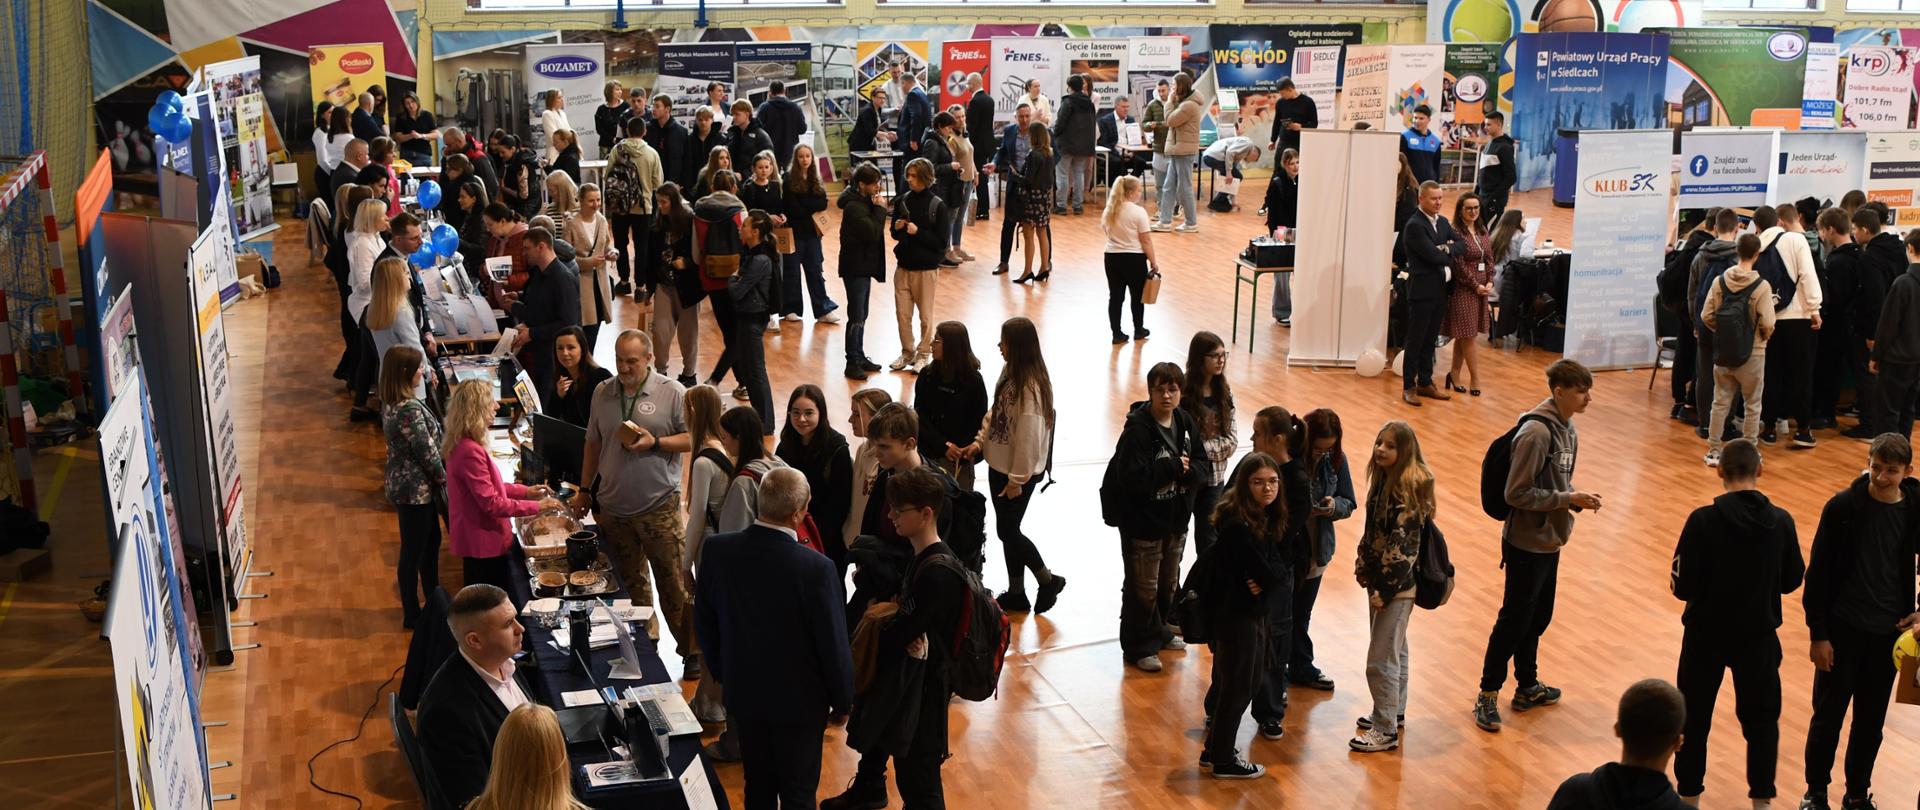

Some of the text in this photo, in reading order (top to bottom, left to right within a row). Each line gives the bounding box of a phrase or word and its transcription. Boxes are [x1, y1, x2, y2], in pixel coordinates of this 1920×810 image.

[1288, 30, 1311, 38] Oglądaj
[1065, 42, 1127, 52] Cięcie laserowe
[1318, 38, 1344, 46] kablowej
[950, 48, 979, 60] FENES
[1005, 50, 1042, 62] FENES
[1313, 51, 1337, 61] SIEDLCE
[1552, 51, 1662, 66] Powiatowy Urząd Pracy
[1851, 53, 1883, 70] krp
[540, 62, 593, 73] BOZAMET
[1550, 67, 1599, 78] w Siedlcach
[1854, 98, 1892, 107] 101,7 fm
[1859, 112, 1897, 121] 106,0 fm
[1713, 155, 1737, 166] Znajdź
[1791, 152, 1838, 163] Jeden Urząd-
[1721, 166, 1757, 175] facebooku
[1594, 172, 1659, 193] KLUB 3K
[1869, 192, 1911, 204] Zainwestuj
